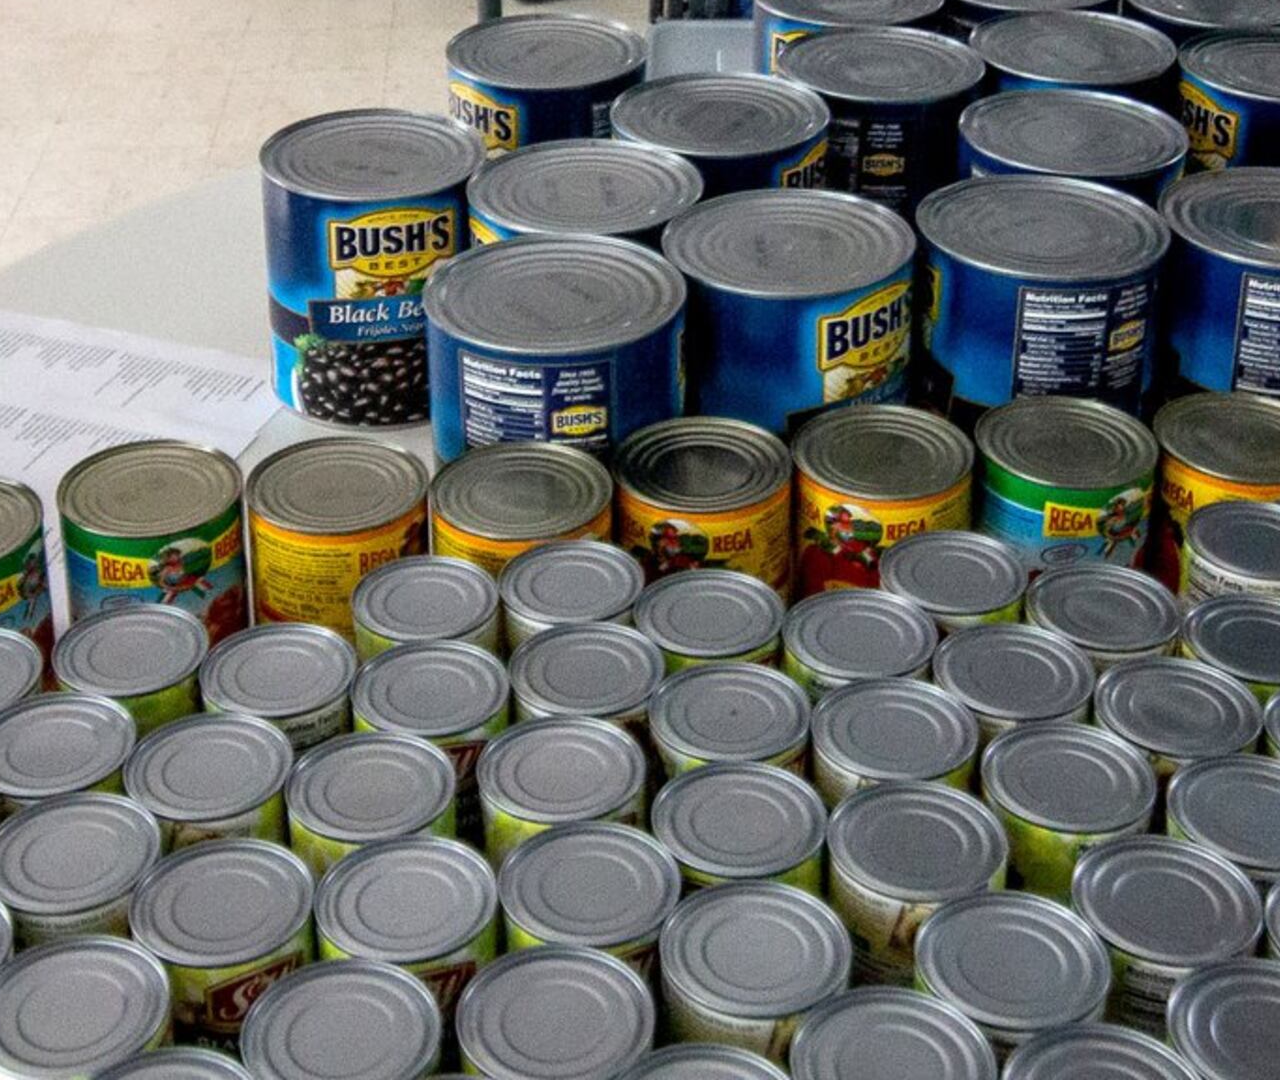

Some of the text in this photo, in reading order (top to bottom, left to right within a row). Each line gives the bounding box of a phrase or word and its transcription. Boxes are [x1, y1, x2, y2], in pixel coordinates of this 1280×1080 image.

[335, 215, 450, 262] BUSH'S
[369, 257, 422, 270] BEST
[1025, 291, 1108, 304] Nutrition Facts
[328, 299, 425, 324] Black Be
[556, 411, 603, 429] BUSH'S
[1048, 506, 1093, 533] REGA
[712, 529, 754, 553] REGA
[100, 555, 144, 582] REGA
